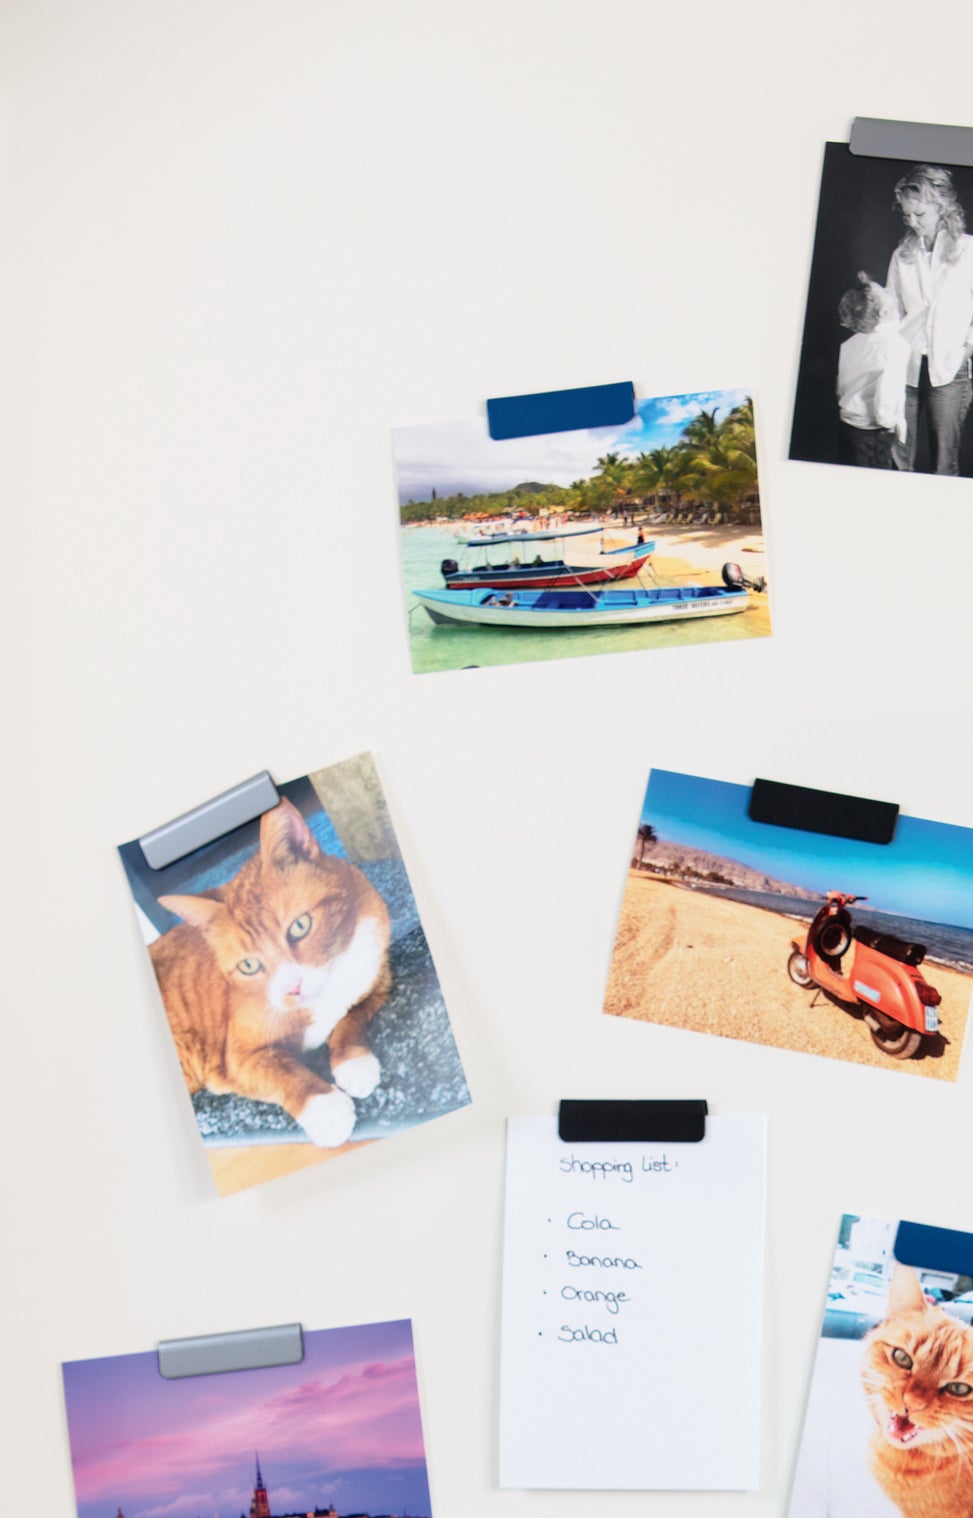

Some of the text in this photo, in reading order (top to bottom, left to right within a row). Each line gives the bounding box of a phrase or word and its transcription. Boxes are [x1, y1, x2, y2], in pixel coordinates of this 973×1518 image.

[559, 1154, 633, 1183] Shopping
[566, 1211, 621, 1231] Cola
[565, 1250, 643, 1270] Banana
[560, 1285, 631, 1315] Orange
[557, 1325, 618, 1345] Salad
